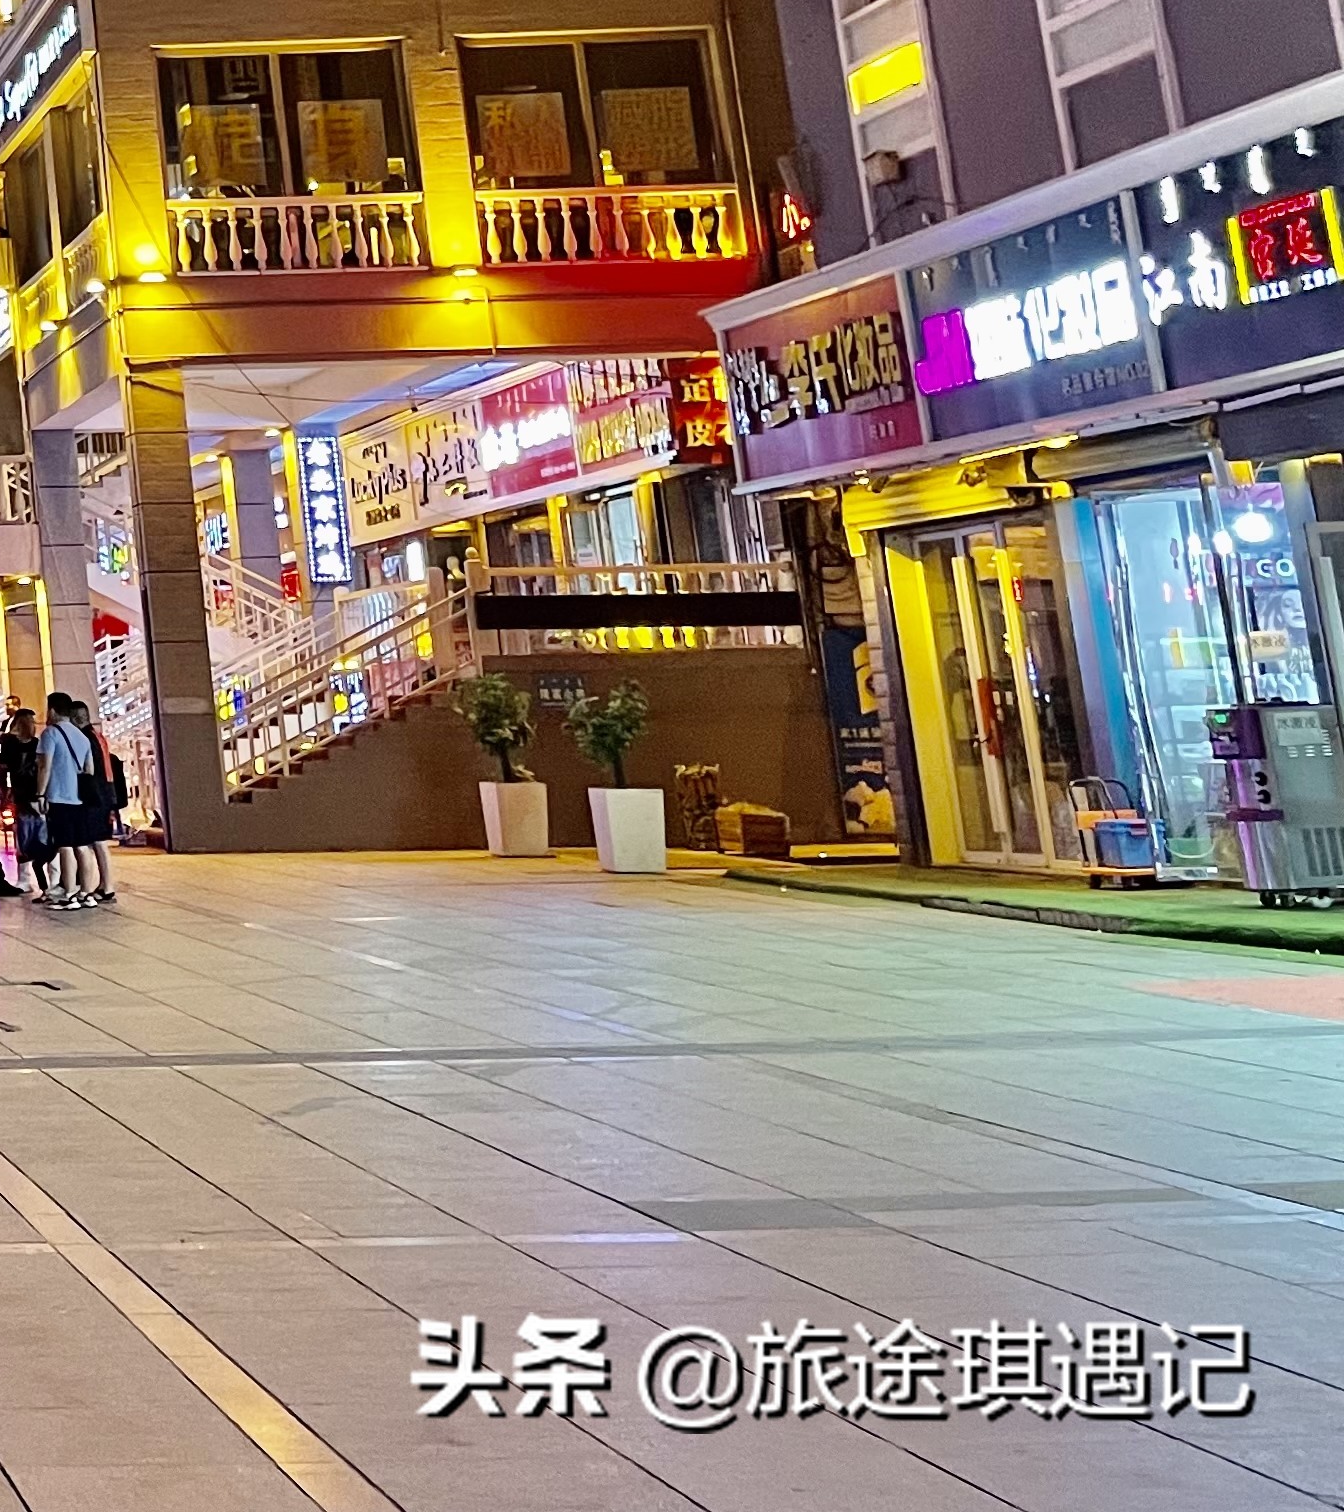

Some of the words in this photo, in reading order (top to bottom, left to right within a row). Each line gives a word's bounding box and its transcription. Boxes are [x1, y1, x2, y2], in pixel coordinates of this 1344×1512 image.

[782, 312, 902, 419] 李氏化妆品
[965, 260, 1138, 381] 化妆品
